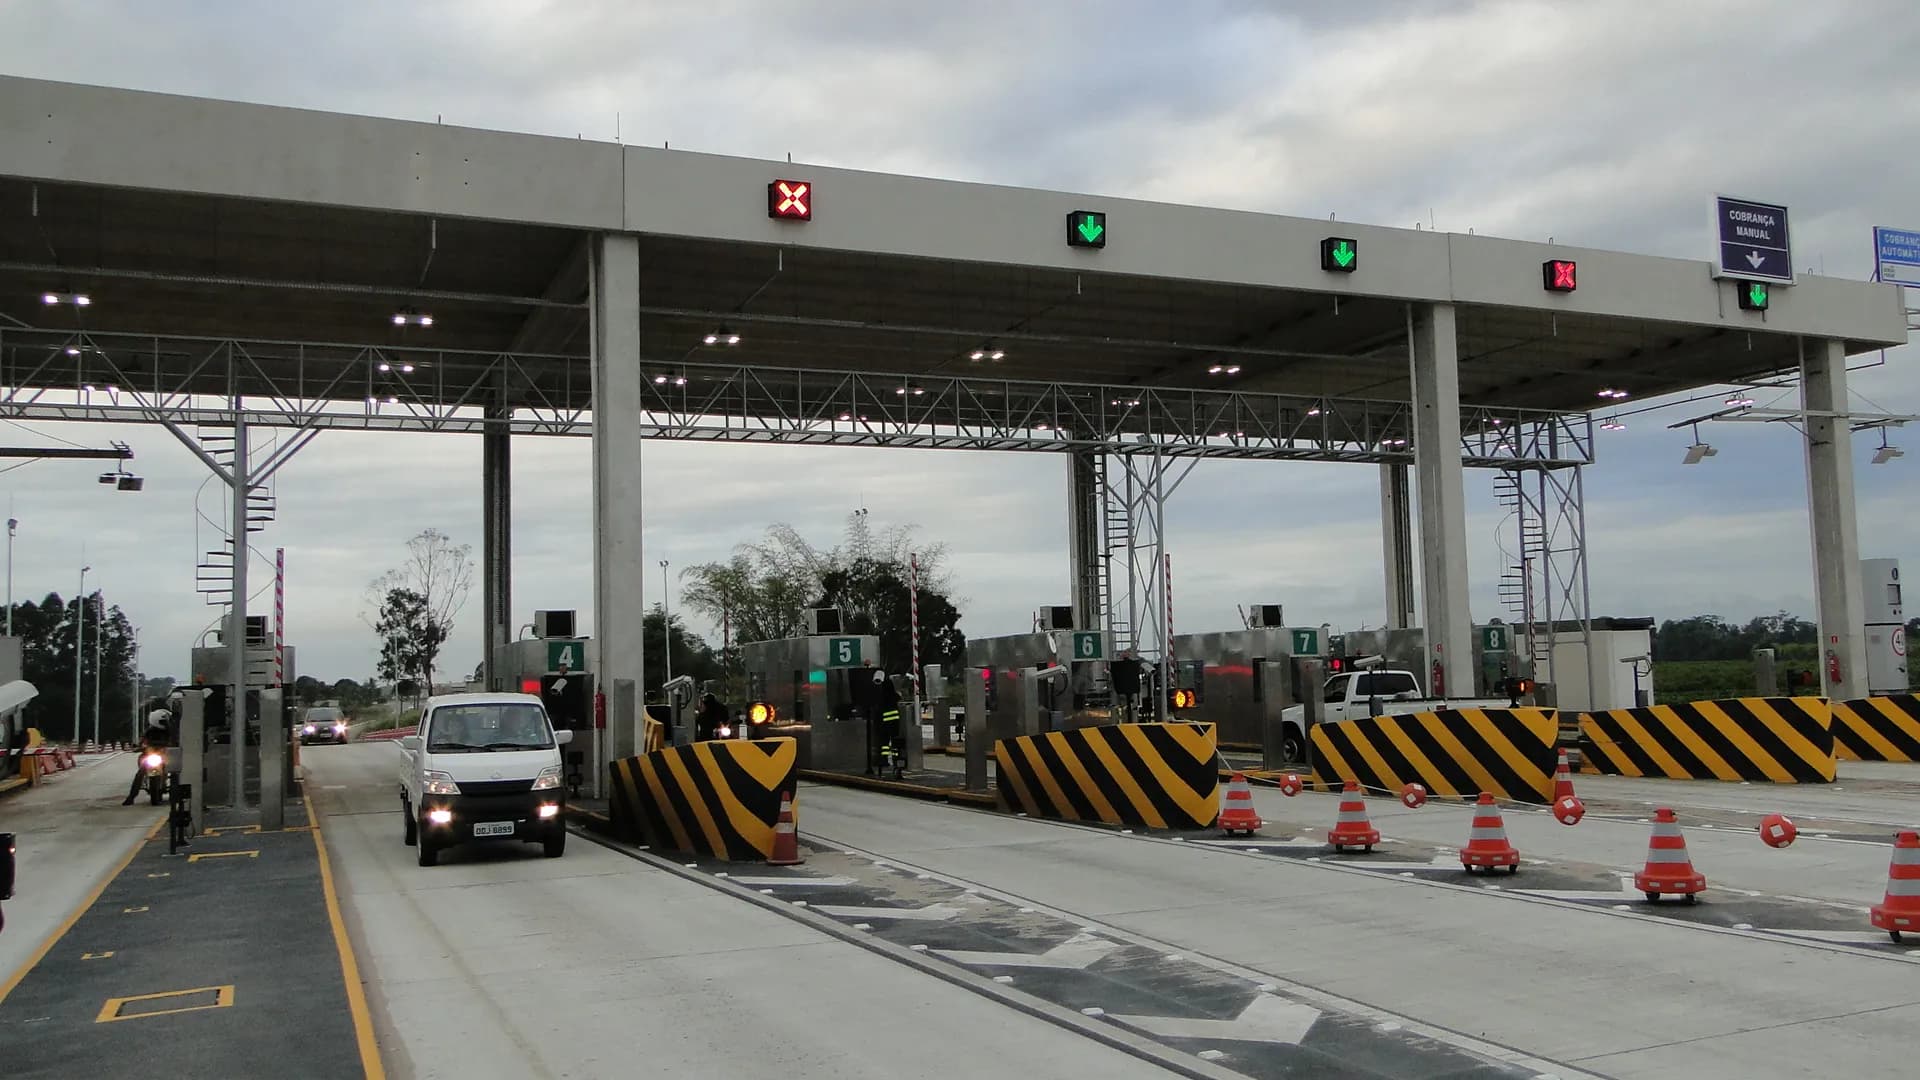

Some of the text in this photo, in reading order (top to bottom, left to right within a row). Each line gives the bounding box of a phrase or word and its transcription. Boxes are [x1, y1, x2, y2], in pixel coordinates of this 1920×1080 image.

[1729, 210, 1775, 227] COBRANÇA
[1736, 226, 1771, 240] MANUAL
[1082, 635, 1094, 656] 6
[1300, 633, 1310, 652] 7
[1490, 630, 1499, 648] 8
[558, 645, 574, 668] 4
[839, 641, 852, 663] 5
